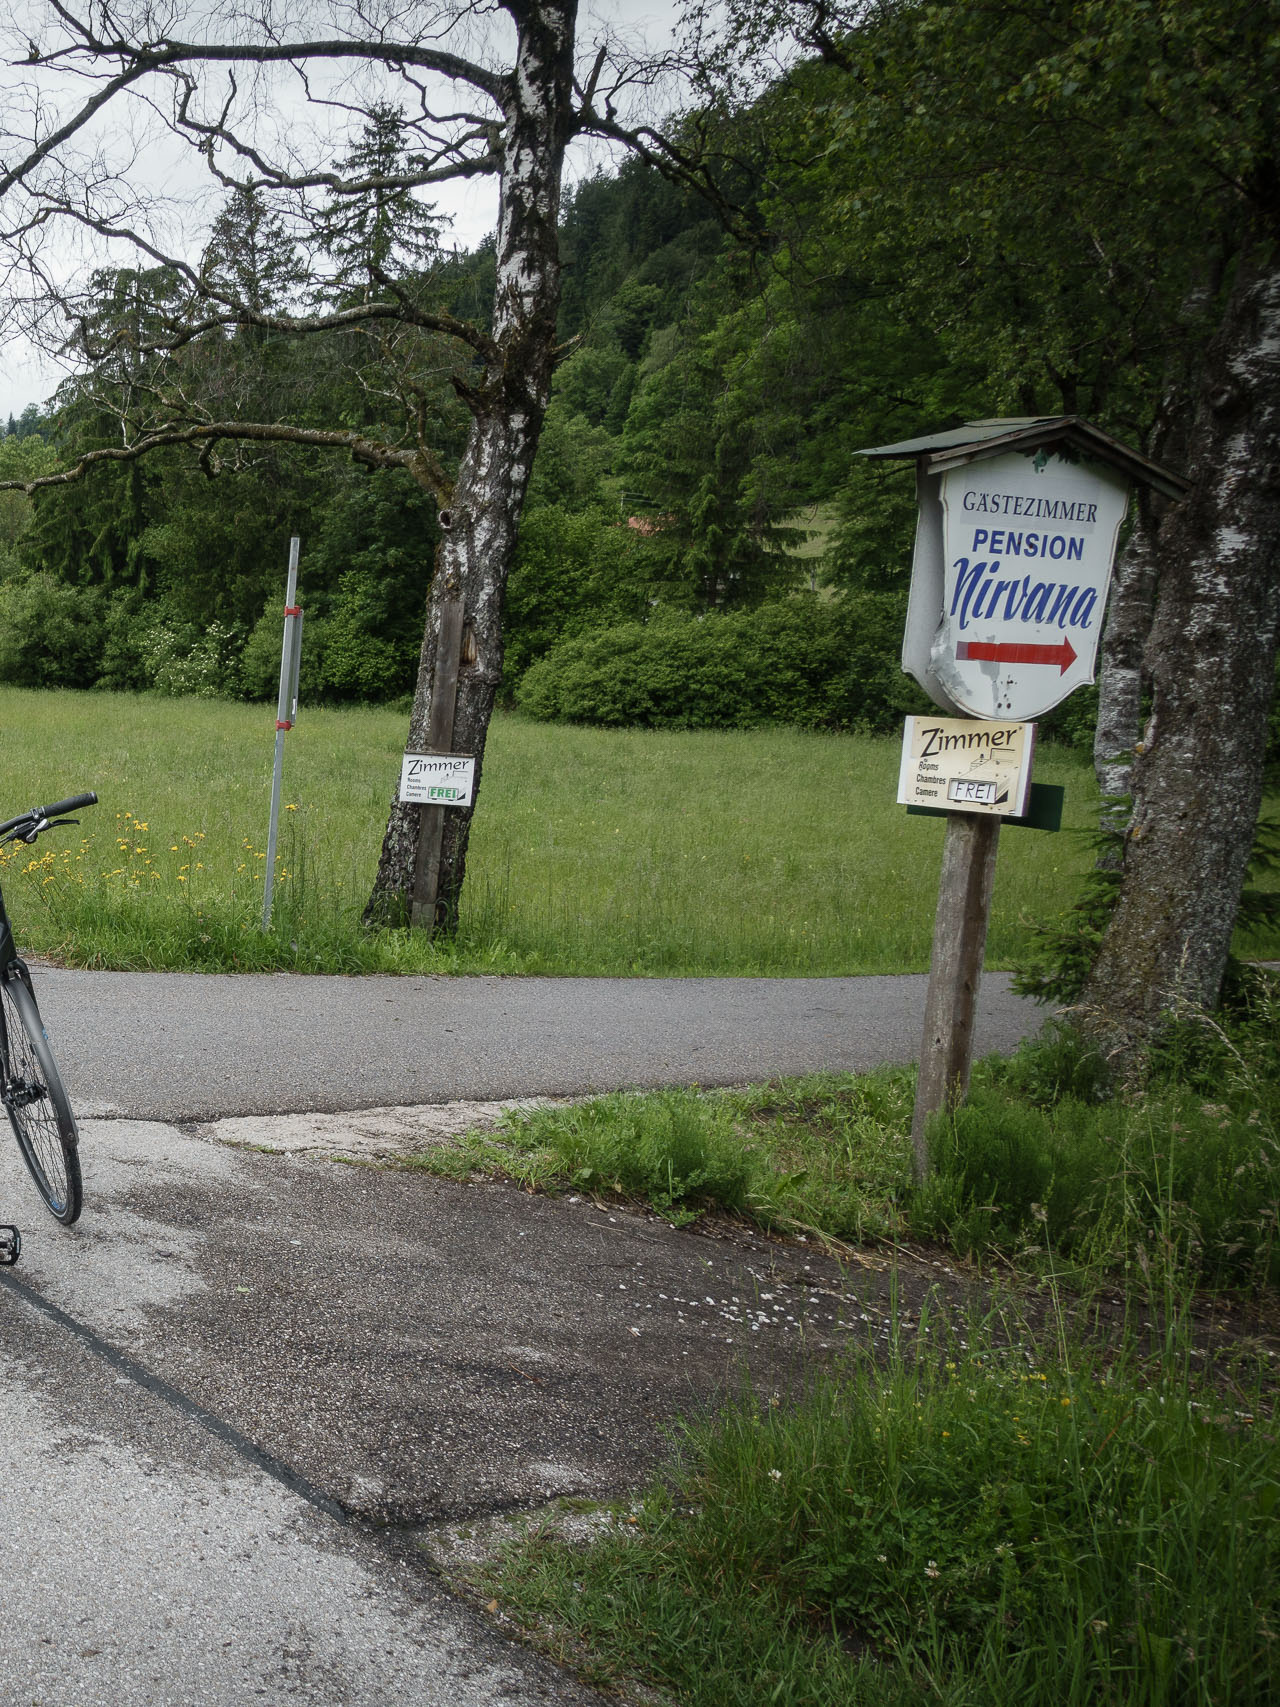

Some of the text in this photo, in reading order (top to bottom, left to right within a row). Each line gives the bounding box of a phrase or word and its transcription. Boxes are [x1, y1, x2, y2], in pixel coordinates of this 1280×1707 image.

[963, 491, 1098, 523] GÄSTEZIMMER
[972, 529, 1085, 560] PENSION
[950, 558, 1099, 630] Nirvana
[920, 728, 1018, 758] Zimmer
[408, 760, 469, 775] Zimmer
[918, 761, 939, 771] Rooms
[916, 774, 946, 785] Chambres
[430, 788, 457, 798] FREI
[915, 787, 939, 797] Camere
[955, 782, 991, 799] FREI
